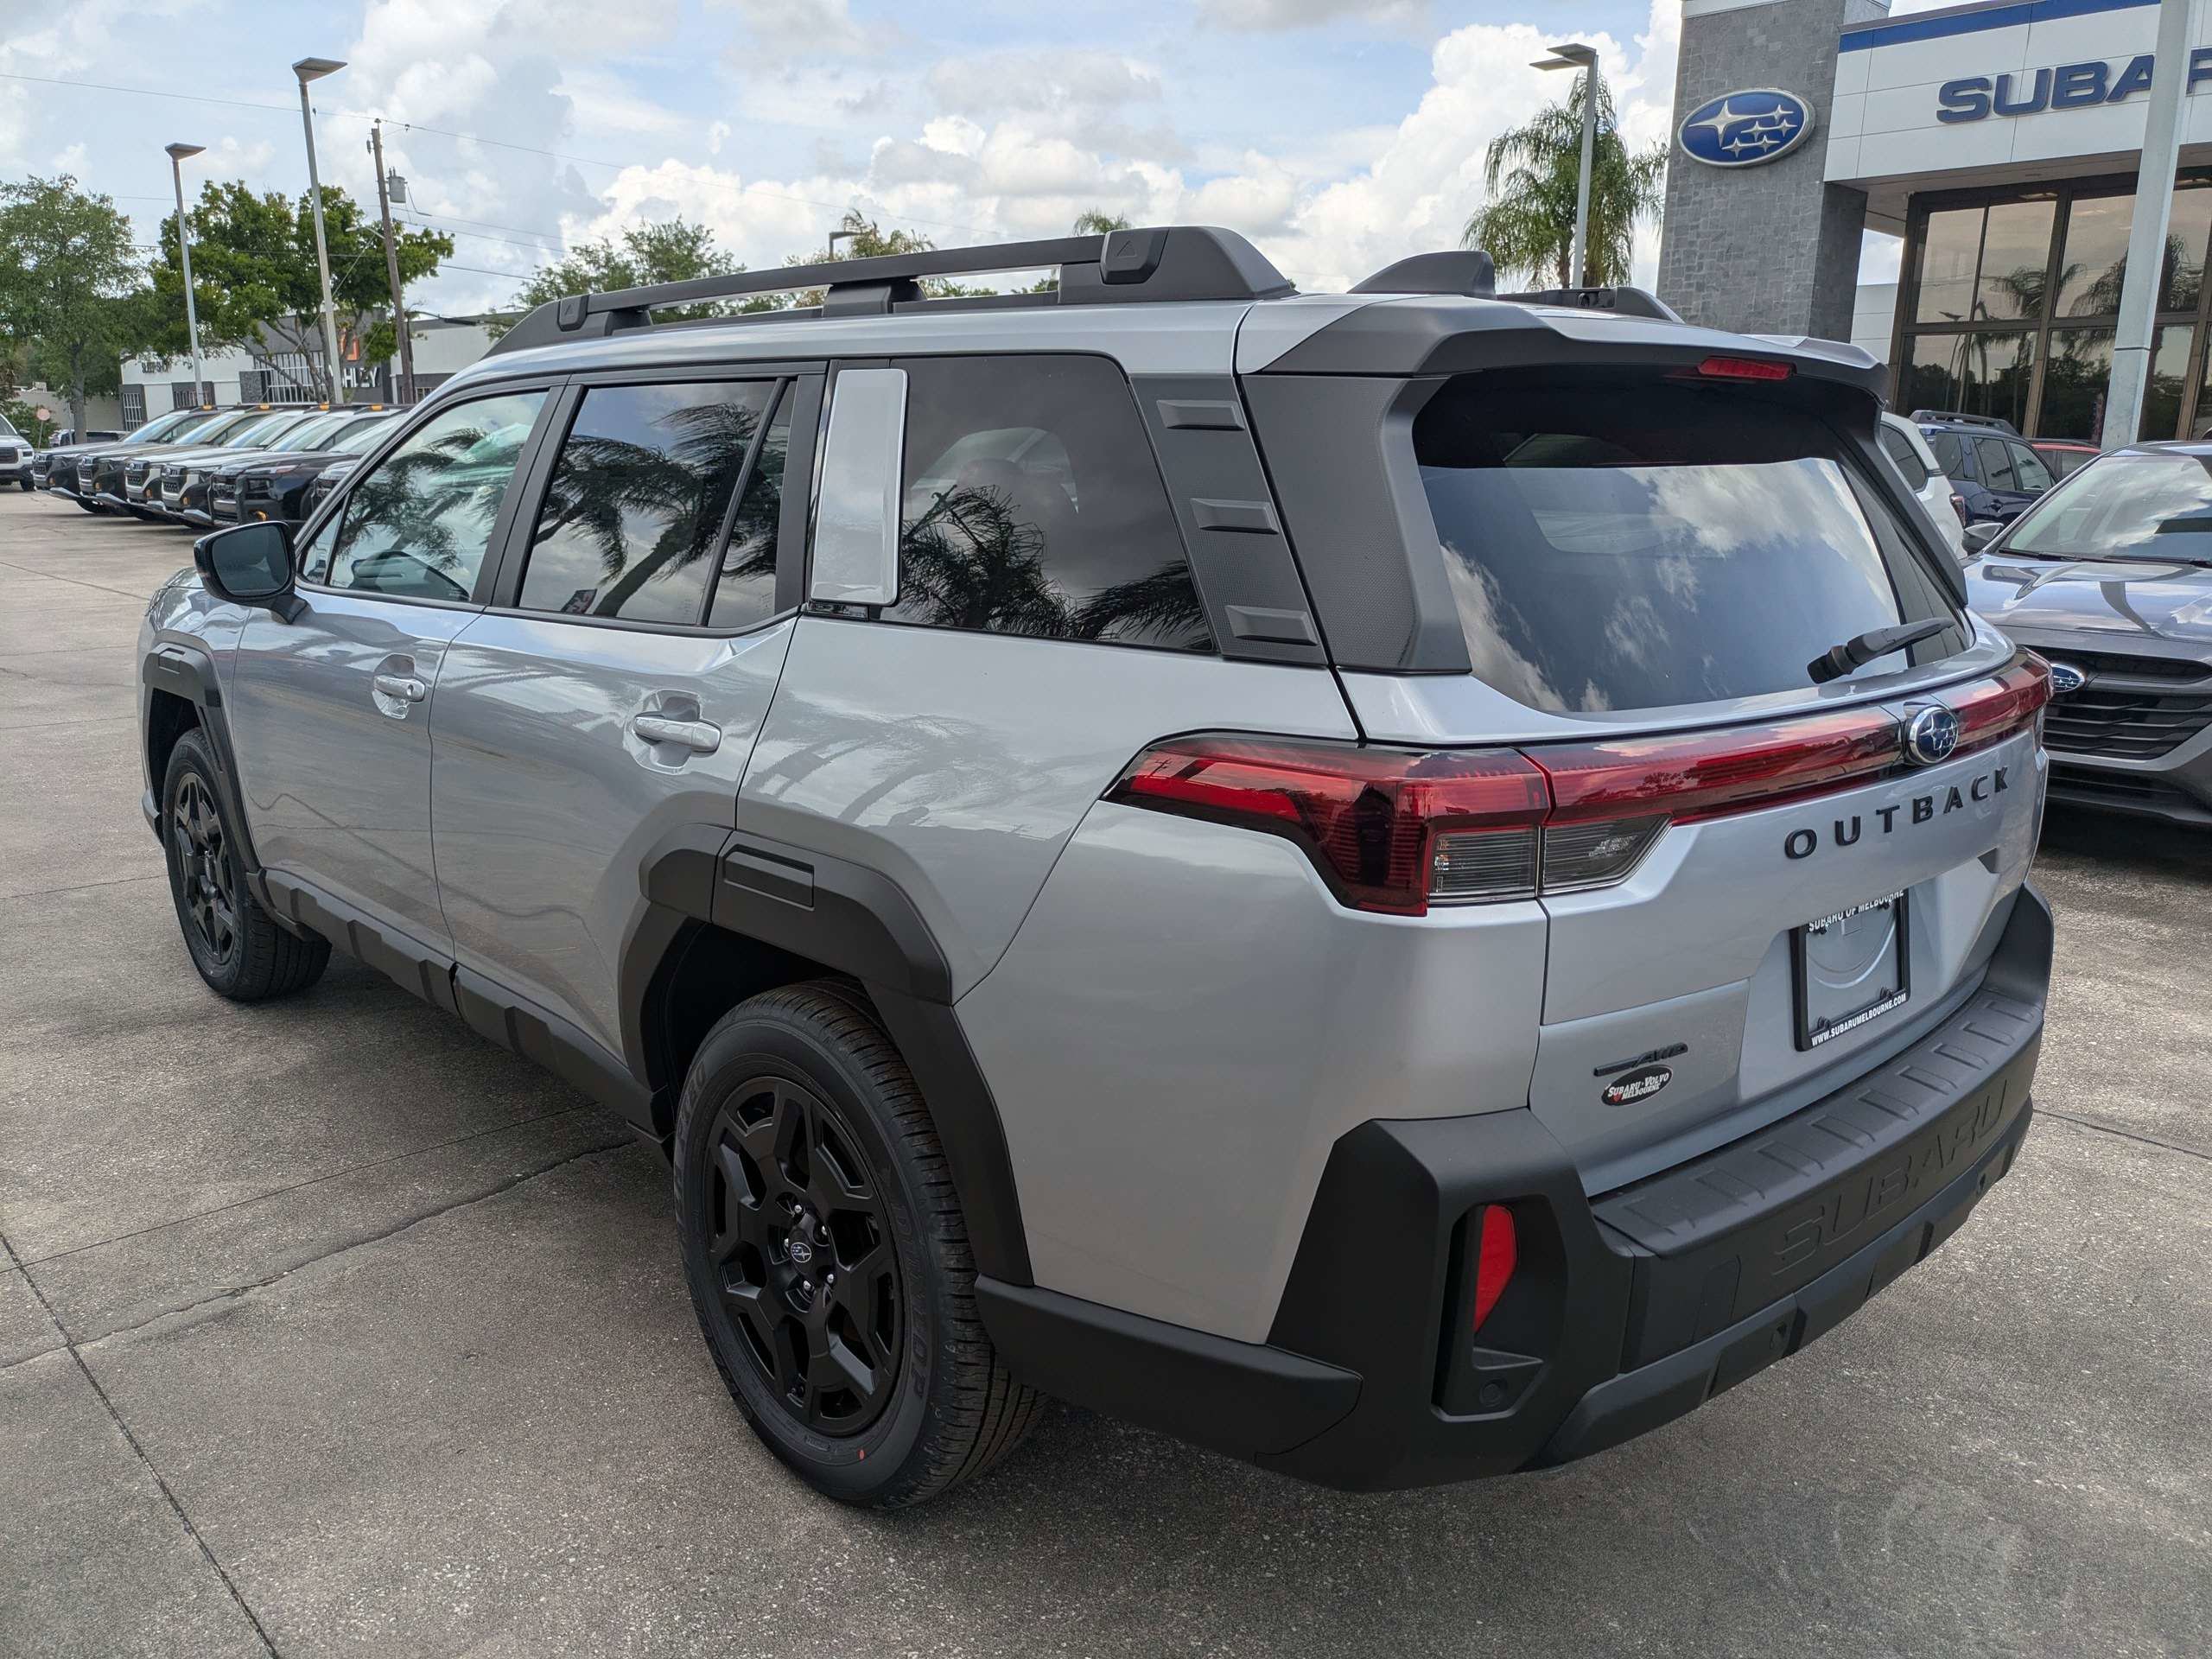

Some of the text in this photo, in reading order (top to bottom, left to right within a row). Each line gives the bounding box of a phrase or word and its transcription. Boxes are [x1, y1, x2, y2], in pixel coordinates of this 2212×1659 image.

[1784, 766, 2008, 860] OUTBACK
[1811, 993, 1906, 1046] WWW.SUBARUMELBOURNE.COM
[1771, 1078, 2007, 1276] SUBARU
